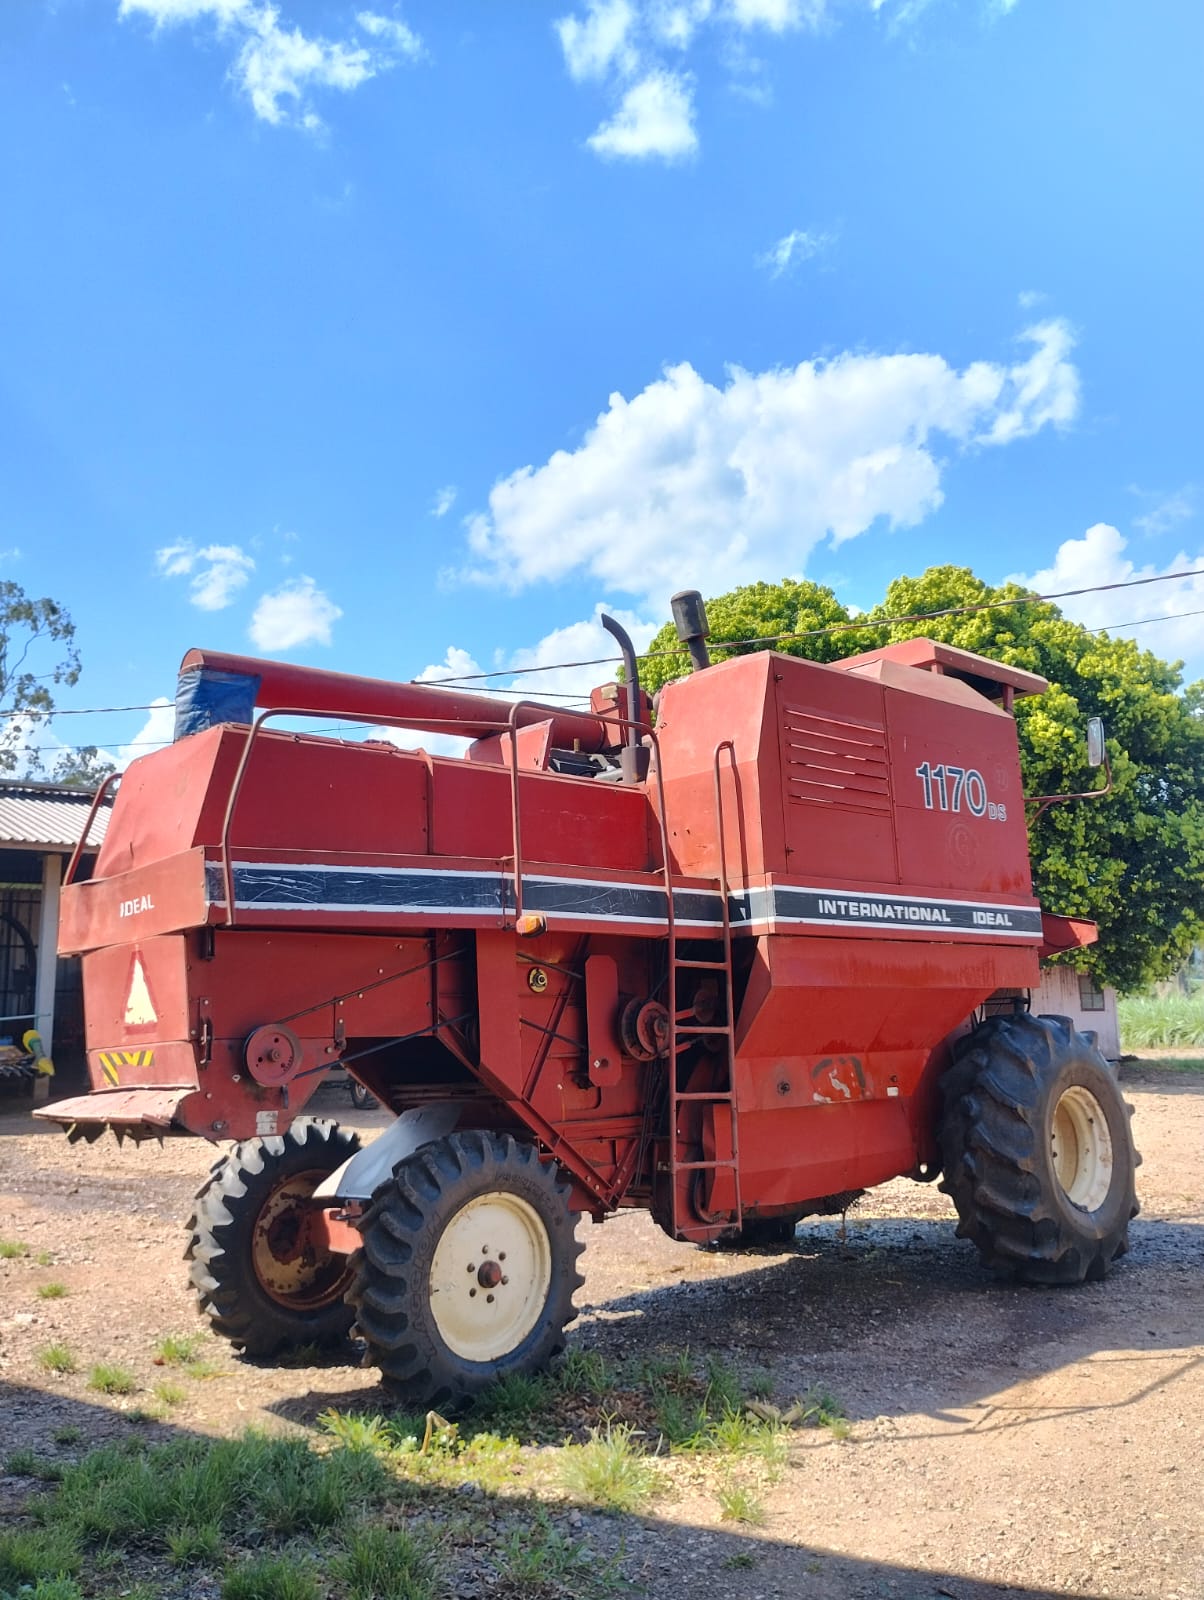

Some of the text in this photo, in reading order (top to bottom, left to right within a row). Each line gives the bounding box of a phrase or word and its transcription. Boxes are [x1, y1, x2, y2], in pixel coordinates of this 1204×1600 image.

[916, 762, 1007, 821] 1170 DS
[120, 894, 155, 917] IDEAL
[818, 899, 1012, 926] INTERNATIONAL IDEAL
